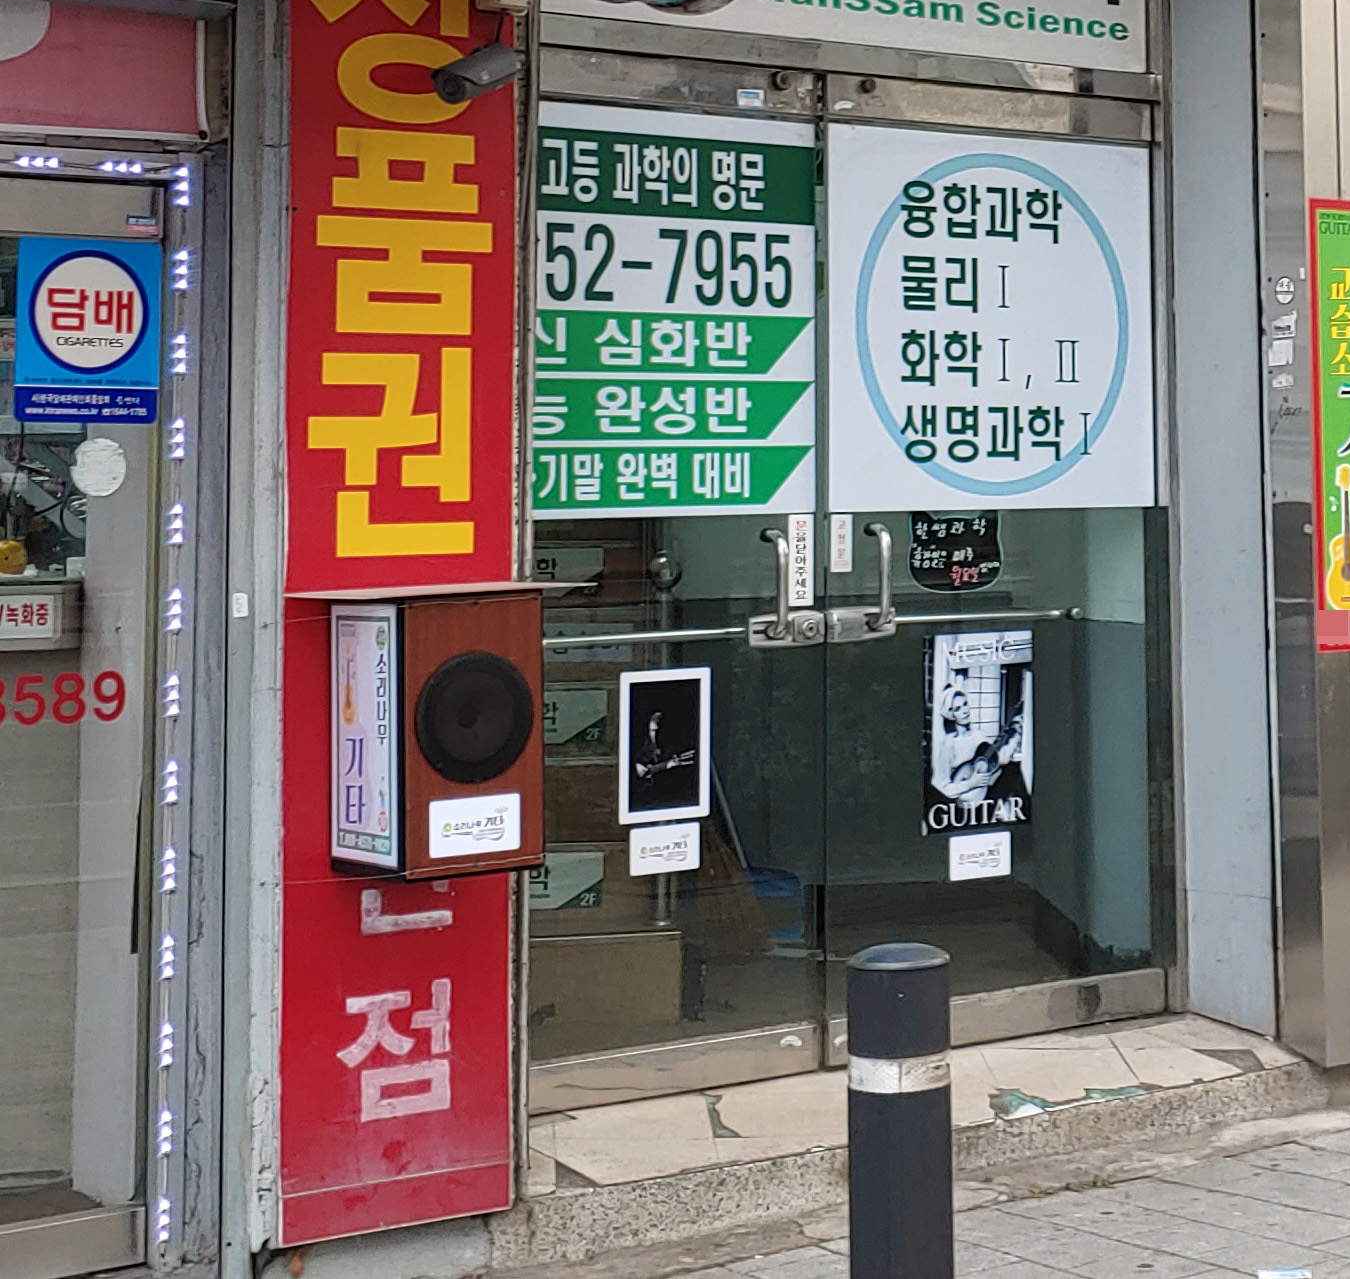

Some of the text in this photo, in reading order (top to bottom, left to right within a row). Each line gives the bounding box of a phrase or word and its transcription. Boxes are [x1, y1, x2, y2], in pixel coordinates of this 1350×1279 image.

[976, 0, 1131, 42] Science
[541, 138, 766, 211] 고등 과학의 명문
[900, 180, 1063, 244] 융합과학
[901, 255, 978, 313] 물리
[46, 287, 135, 334] 담배
[56, 336, 124, 348] CIGARETTES
[594, 318, 753, 368] 심화반
[901, 329, 982, 387] 화학
[594, 385, 753, 434] 완성반
[900, 405, 1065, 463] 생명과학
[616, 452, 679, 500] 완벽
[692, 452, 752, 500] 대비
[0, 603, 49, 626] 녹화중
[943, 639, 1016, 662] MUSIC
[0, 670, 126, 726] 589
[376, 653, 388, 746] 소리나무
[344, 737, 366, 825] 기타
[928, 796, 1027, 830] GUITAR
